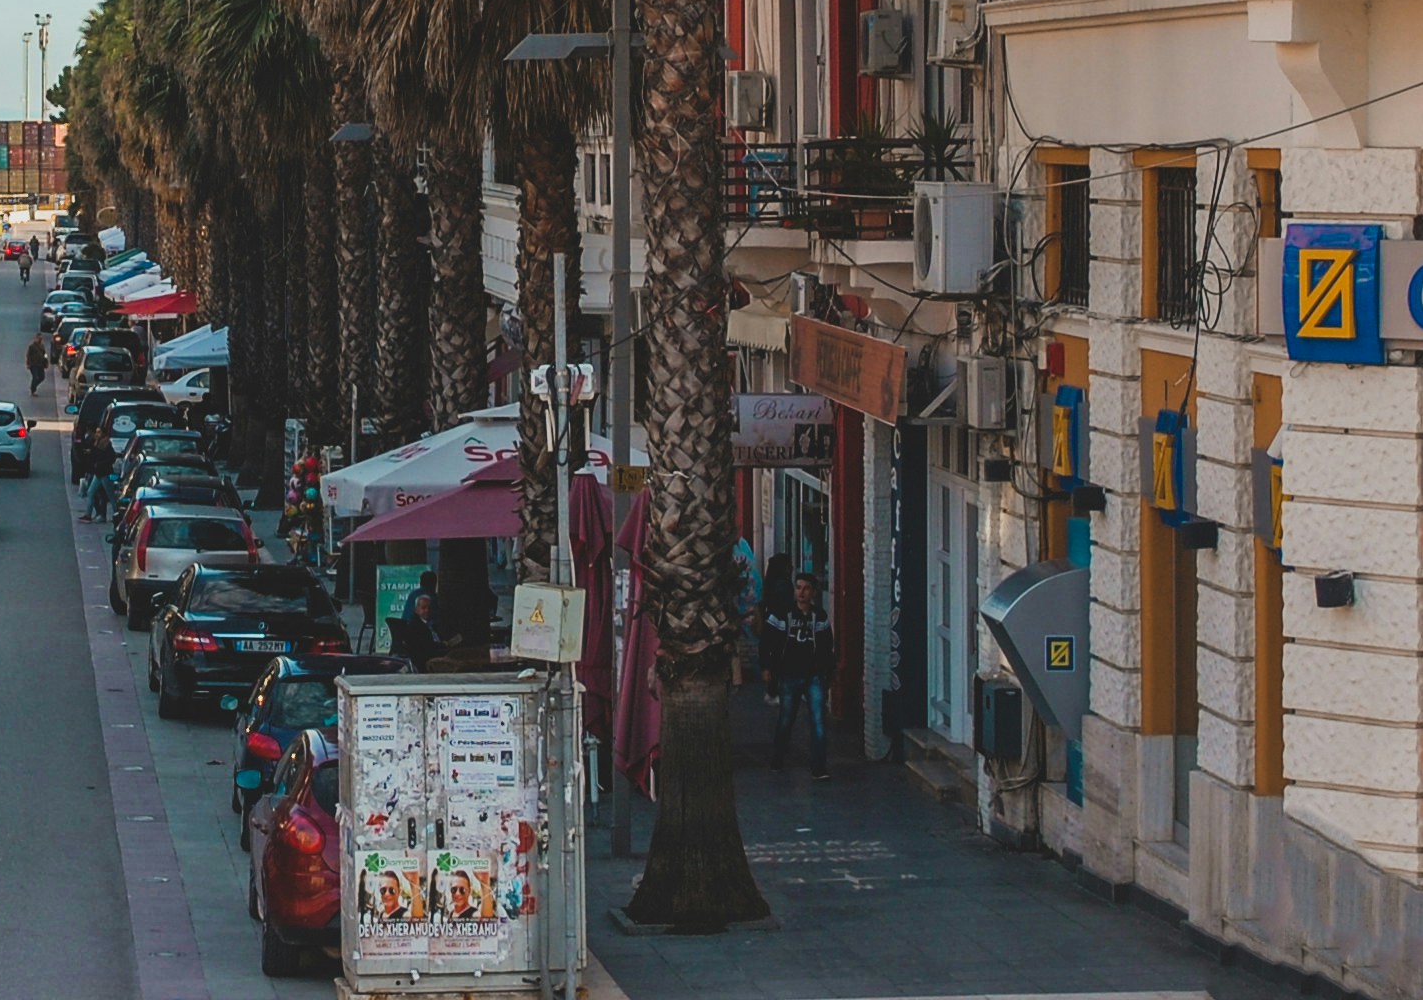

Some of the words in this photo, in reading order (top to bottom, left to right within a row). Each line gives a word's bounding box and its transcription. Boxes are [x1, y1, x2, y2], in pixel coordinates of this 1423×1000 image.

[243, 641, 254, 650] AA
[359, 923, 384, 938] DEVIS
[386, 922, 429, 937] XHERAHU
[428, 923, 454, 938] DEVIS
[457, 922, 498, 937] XHERAHU
